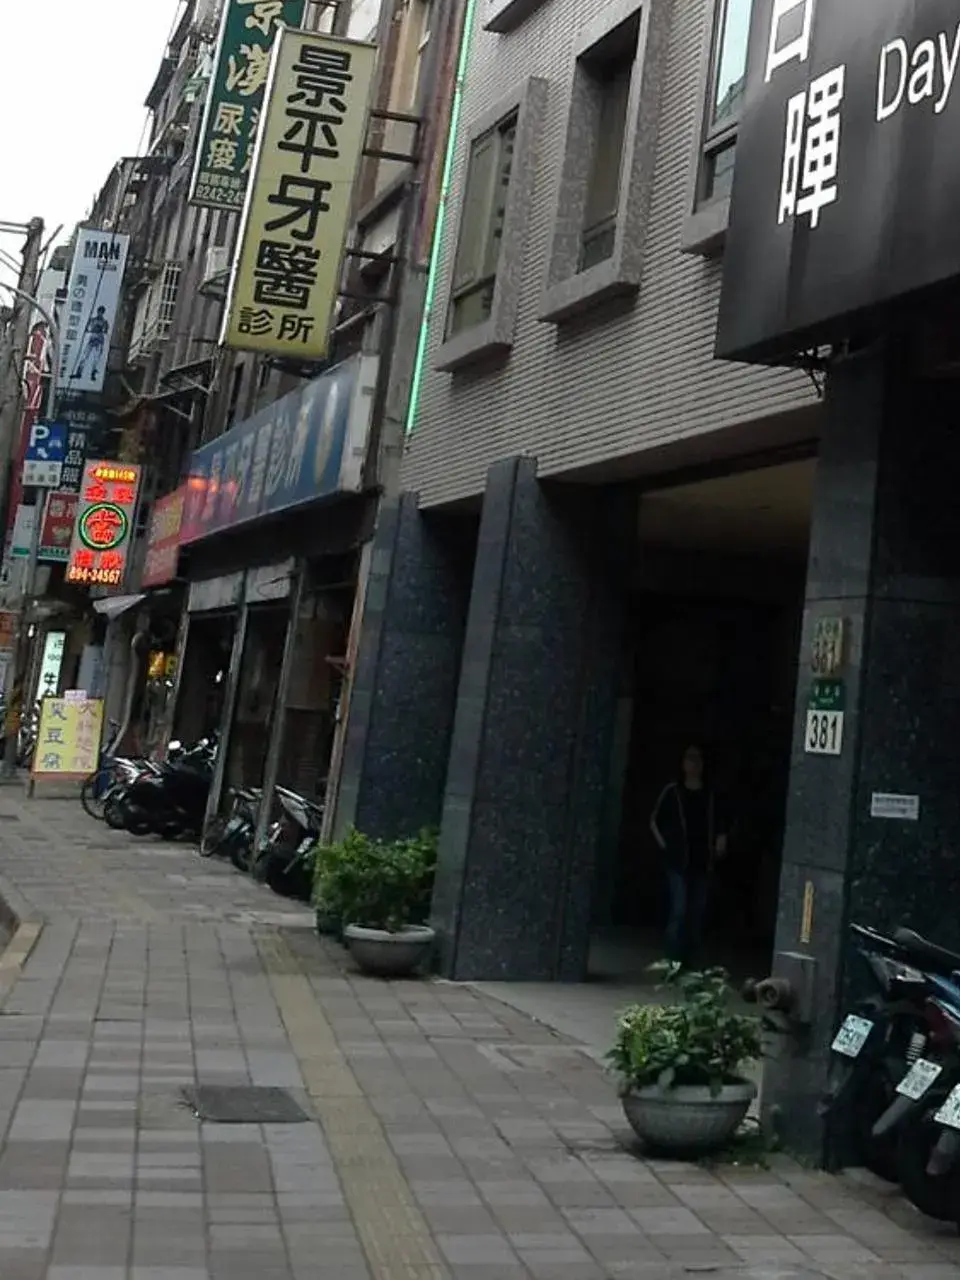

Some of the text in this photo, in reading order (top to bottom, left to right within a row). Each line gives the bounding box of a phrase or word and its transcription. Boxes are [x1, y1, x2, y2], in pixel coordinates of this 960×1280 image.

[253, 43, 354, 311] 景平牙醫
[84, 240, 121, 260] MAN
[237, 306, 316, 345] 診所
[30, 424, 51, 448] P
[809, 714, 839, 750] 381
